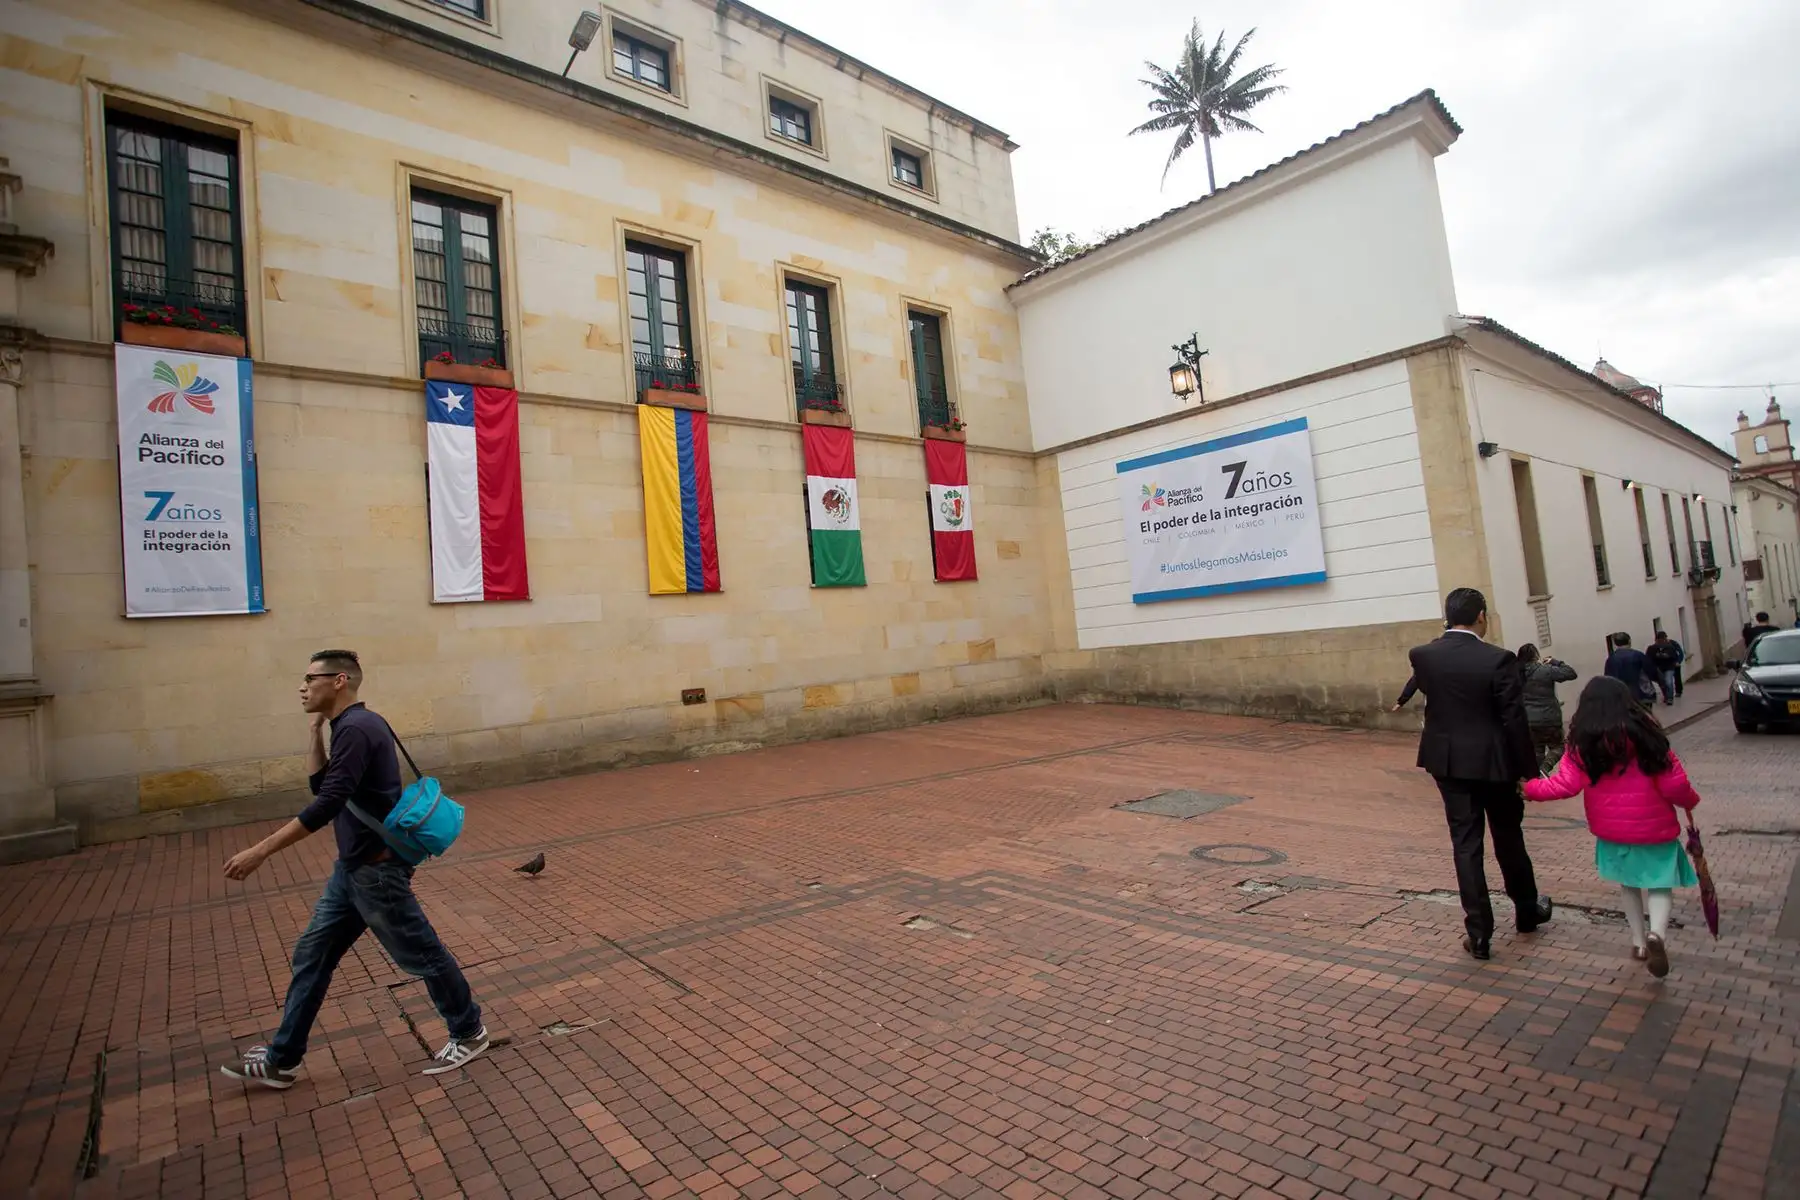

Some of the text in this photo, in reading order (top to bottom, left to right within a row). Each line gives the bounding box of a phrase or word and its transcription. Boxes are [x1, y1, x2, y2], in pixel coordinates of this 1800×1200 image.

[139, 433, 224, 449] Alianza del
[138, 447, 225, 466] Pacífico
[1167, 487, 1192, 498] Alianza
[1167, 494, 1204, 507] Pacífico
[1140, 495, 1303, 533] El poder de la integración
[144, 529, 229, 541] El poder de la
[1178, 528, 1215, 540] COLOMBIA
[143, 540, 231, 553] integración
[1160, 548, 1288, 574] #JuntosLlegamosMásLejos
